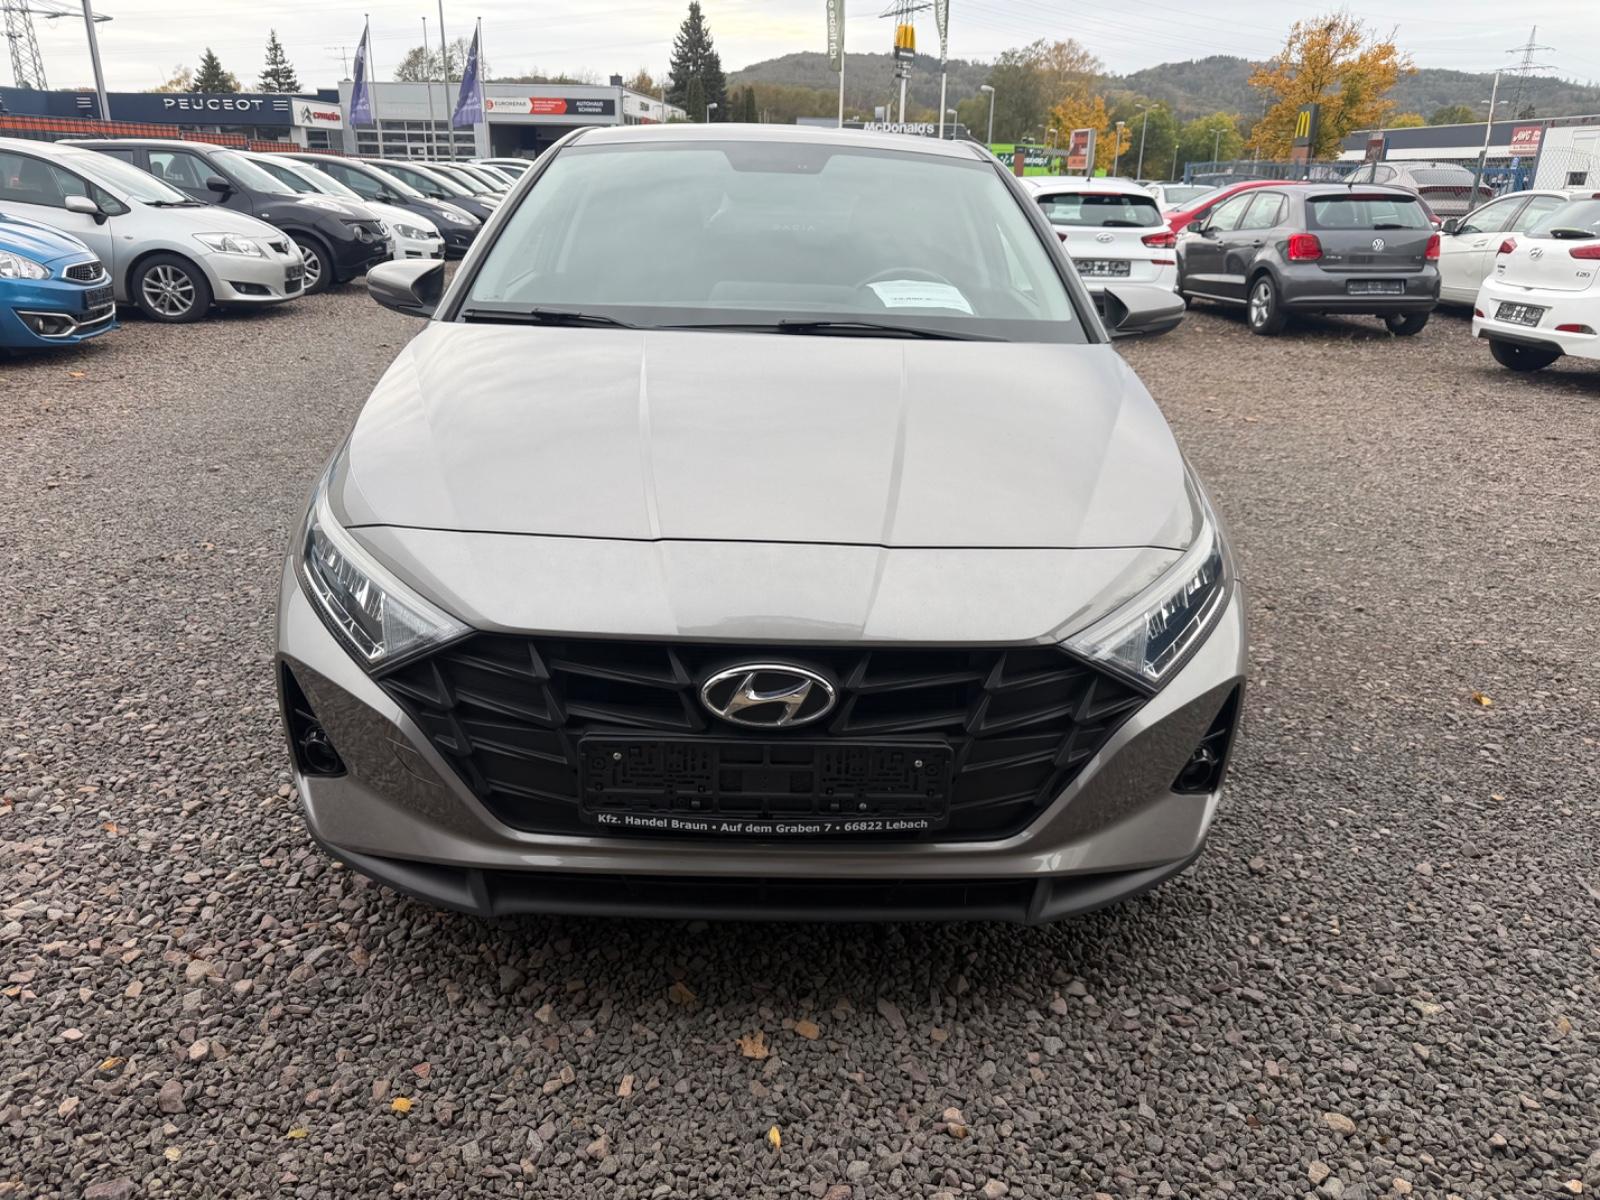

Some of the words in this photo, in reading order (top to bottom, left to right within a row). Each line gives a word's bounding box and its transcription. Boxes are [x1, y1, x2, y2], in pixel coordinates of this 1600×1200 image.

[163, 98, 263, 111] PEUGEOT
[863, 121, 935, 135] McDonald's
[598, 814, 622, 824] Kfz.
[625, 816, 668, 828] Handel
[671, 819, 708, 831] Braun
[720, 823, 742, 832] Auf
[745, 823, 772, 833] dem
[776, 823, 820, 833] Graben
[824, 823, 832, 832] 7
[844, 821, 882, 831] 66822
[886, 819, 928, 830] Lebach
